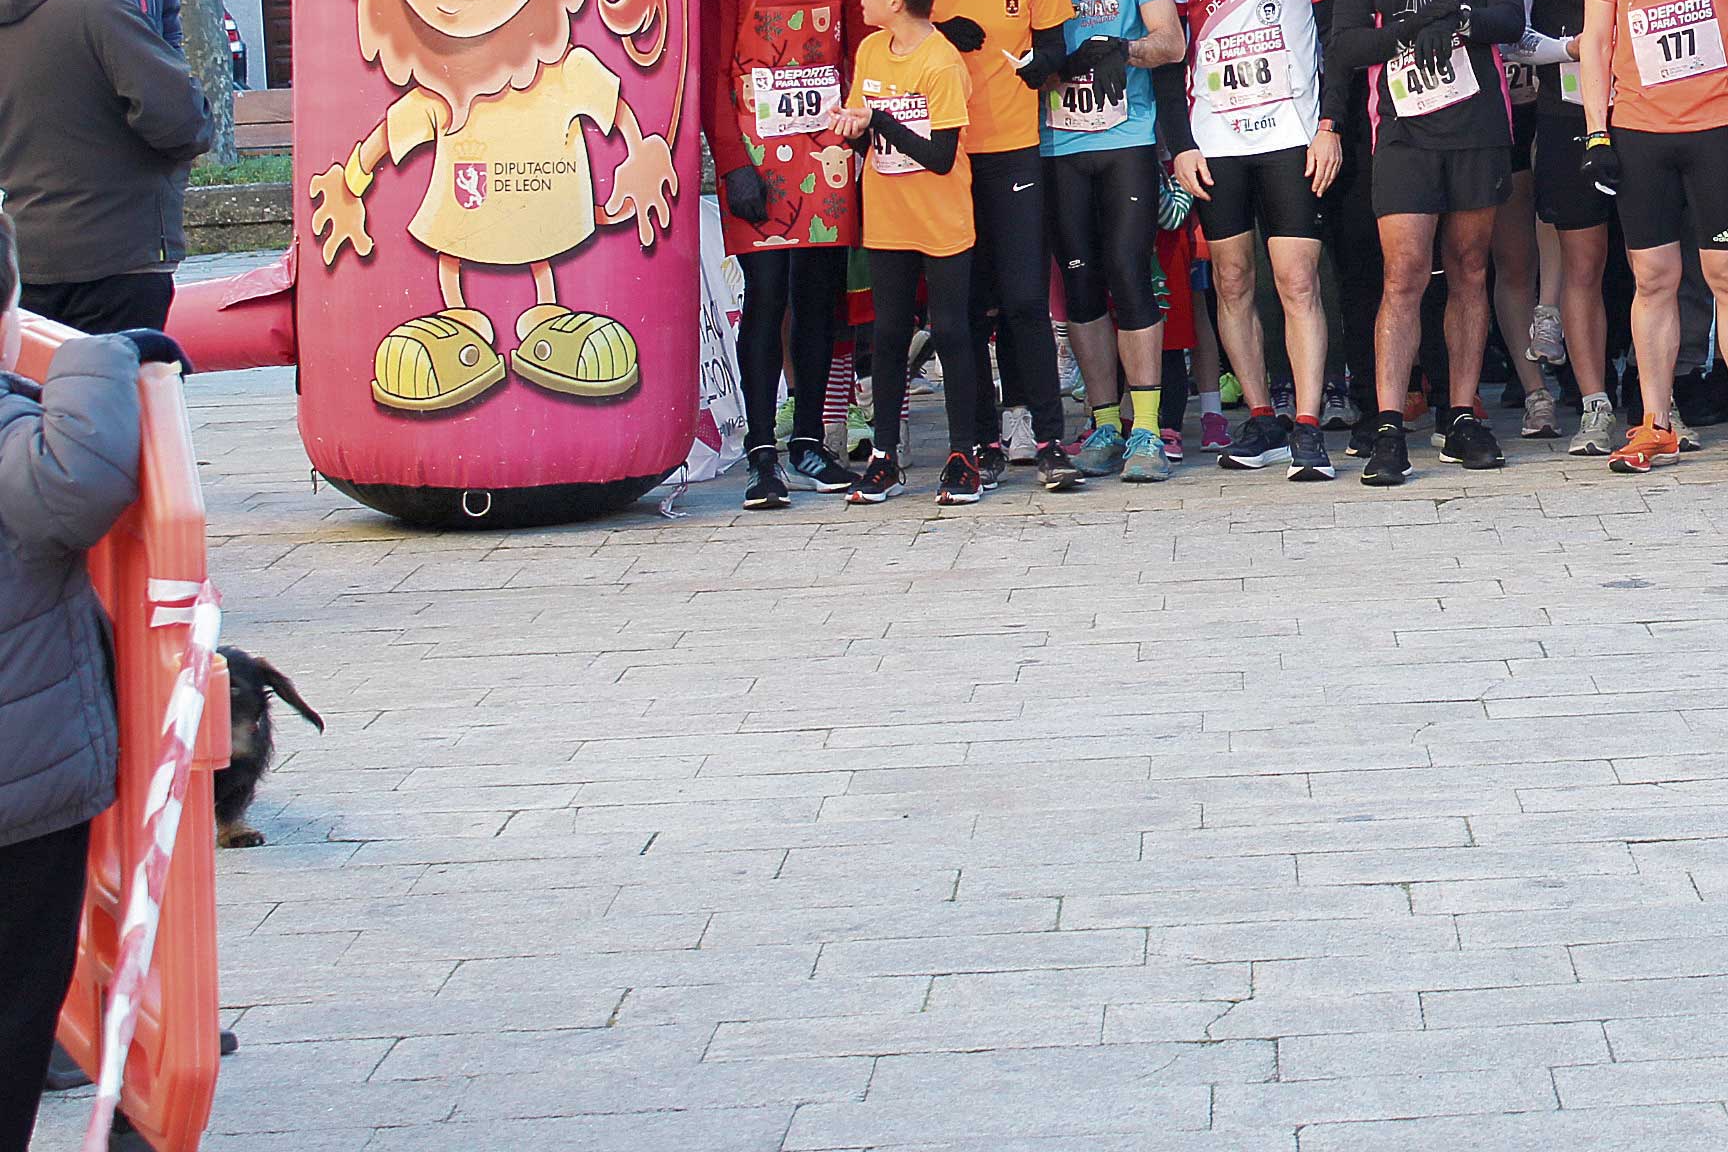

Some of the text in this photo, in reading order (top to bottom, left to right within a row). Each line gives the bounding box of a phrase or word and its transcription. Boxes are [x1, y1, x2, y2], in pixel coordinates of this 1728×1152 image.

[1650, 7, 1714, 32] PARA TODOS
[1220, 26, 1281, 50] DEPORTE
[1656, 28, 1697, 63] 177
[1221, 38, 1283, 60] PARA TODOS
[774, 65, 836, 80] DEPORTE
[775, 75, 837, 89] PARA TODOS
[1223, 57, 1272, 90] 408
[777, 89, 822, 118] 419
[891, 108, 929, 121] TODOS
[1239, 114, 1277, 133] León
[494, 157, 577, 176] DIPUTACIÓN
[494, 175, 552, 192] DE LEÓN
